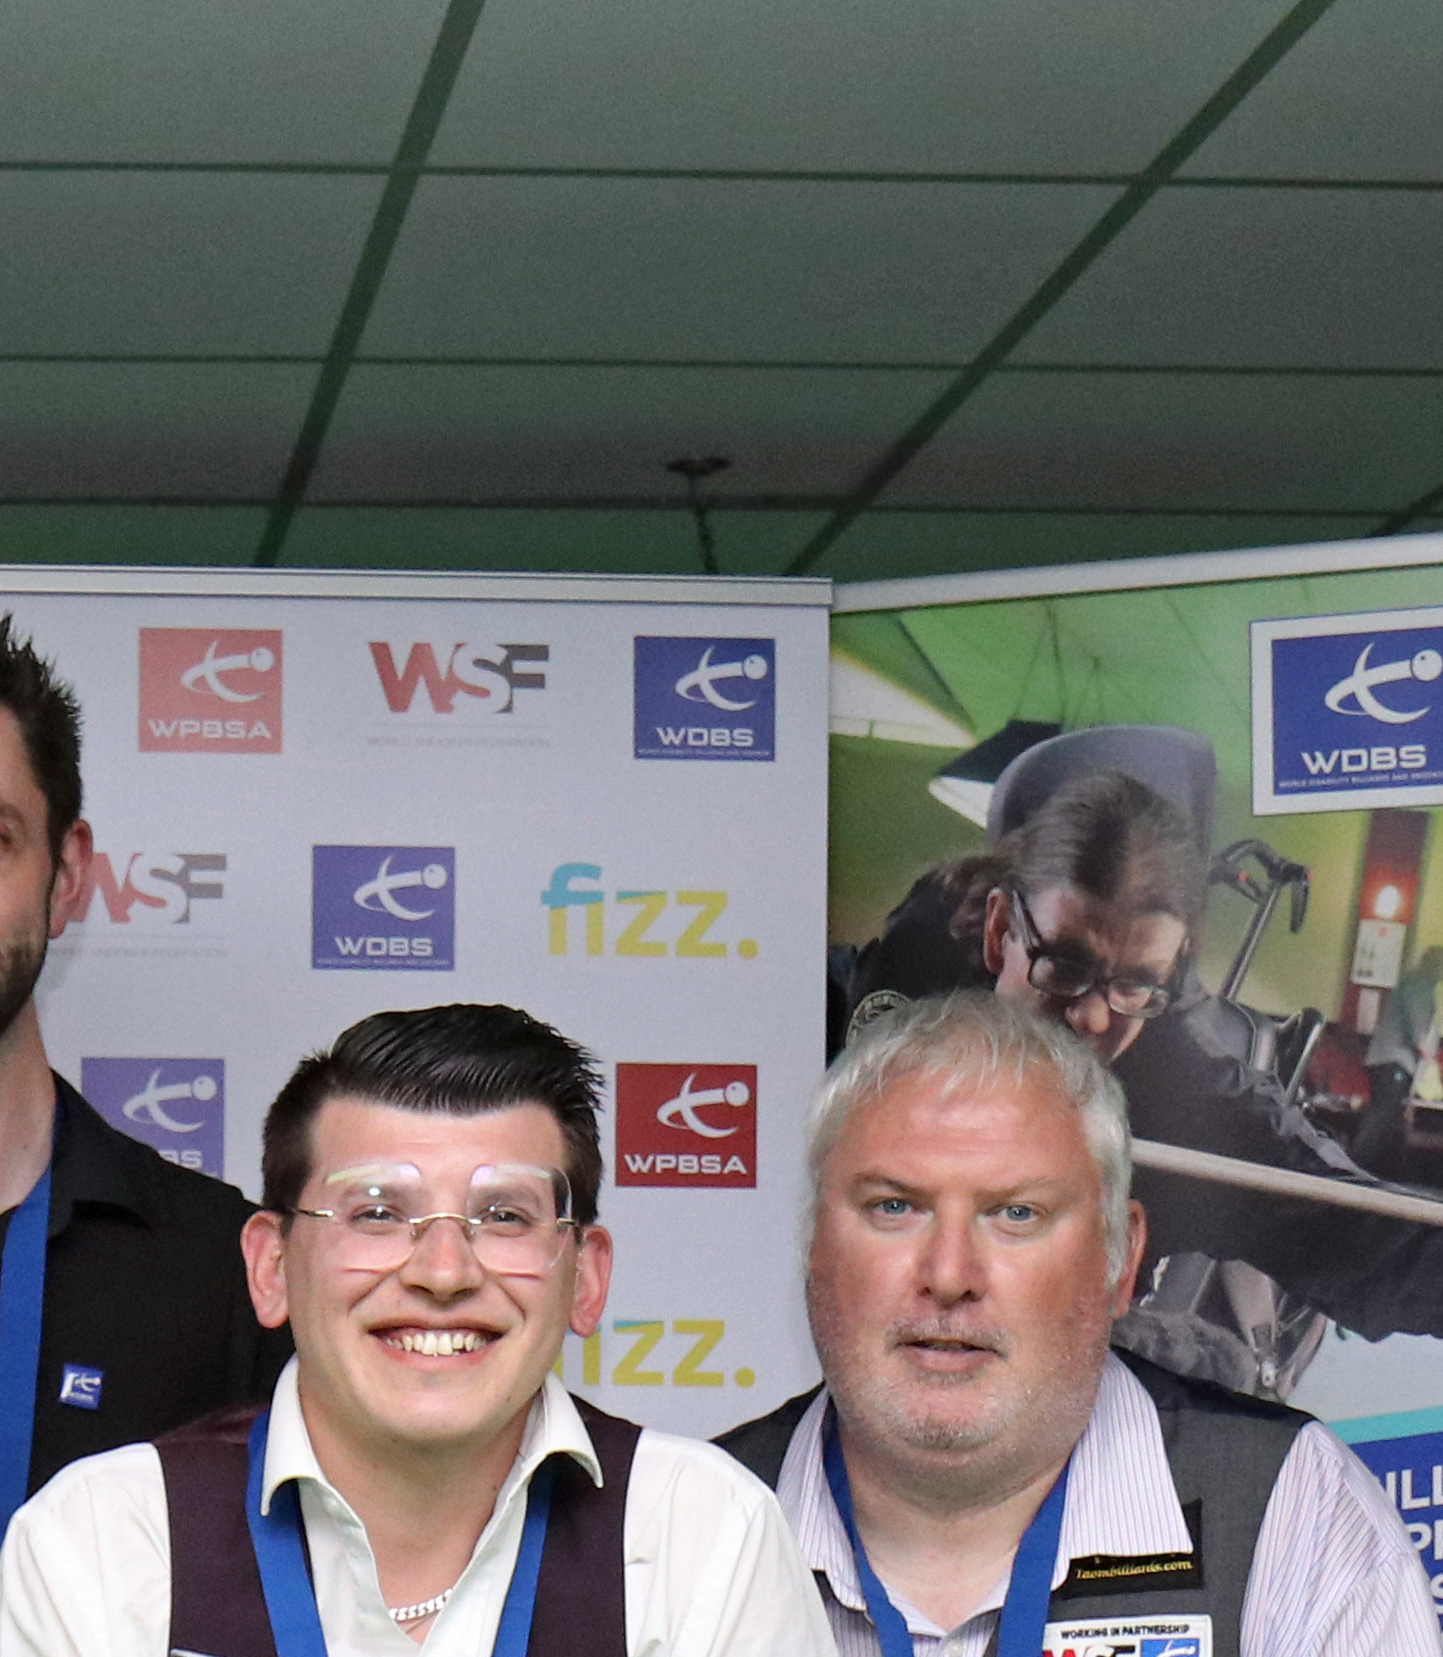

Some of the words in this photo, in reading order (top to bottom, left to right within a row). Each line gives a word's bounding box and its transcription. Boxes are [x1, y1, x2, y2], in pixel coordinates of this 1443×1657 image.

[368, 641, 549, 714] WSF
[147, 719, 271, 740] WPBSA
[656, 727, 754, 747] WDBS
[1301, 744, 1427, 775] WDBS
[541, 862, 759, 960] fizz.
[334, 937, 433, 957] WDBS
[626, 1154, 748, 1175] WPBSA
[552, 1319, 756, 1388] izz.
[1060, 1627, 1108, 1639] WORKING
[1110, 1626, 1120, 1636] IN
[1122, 1624, 1190, 1636] PARTNERSHIP
